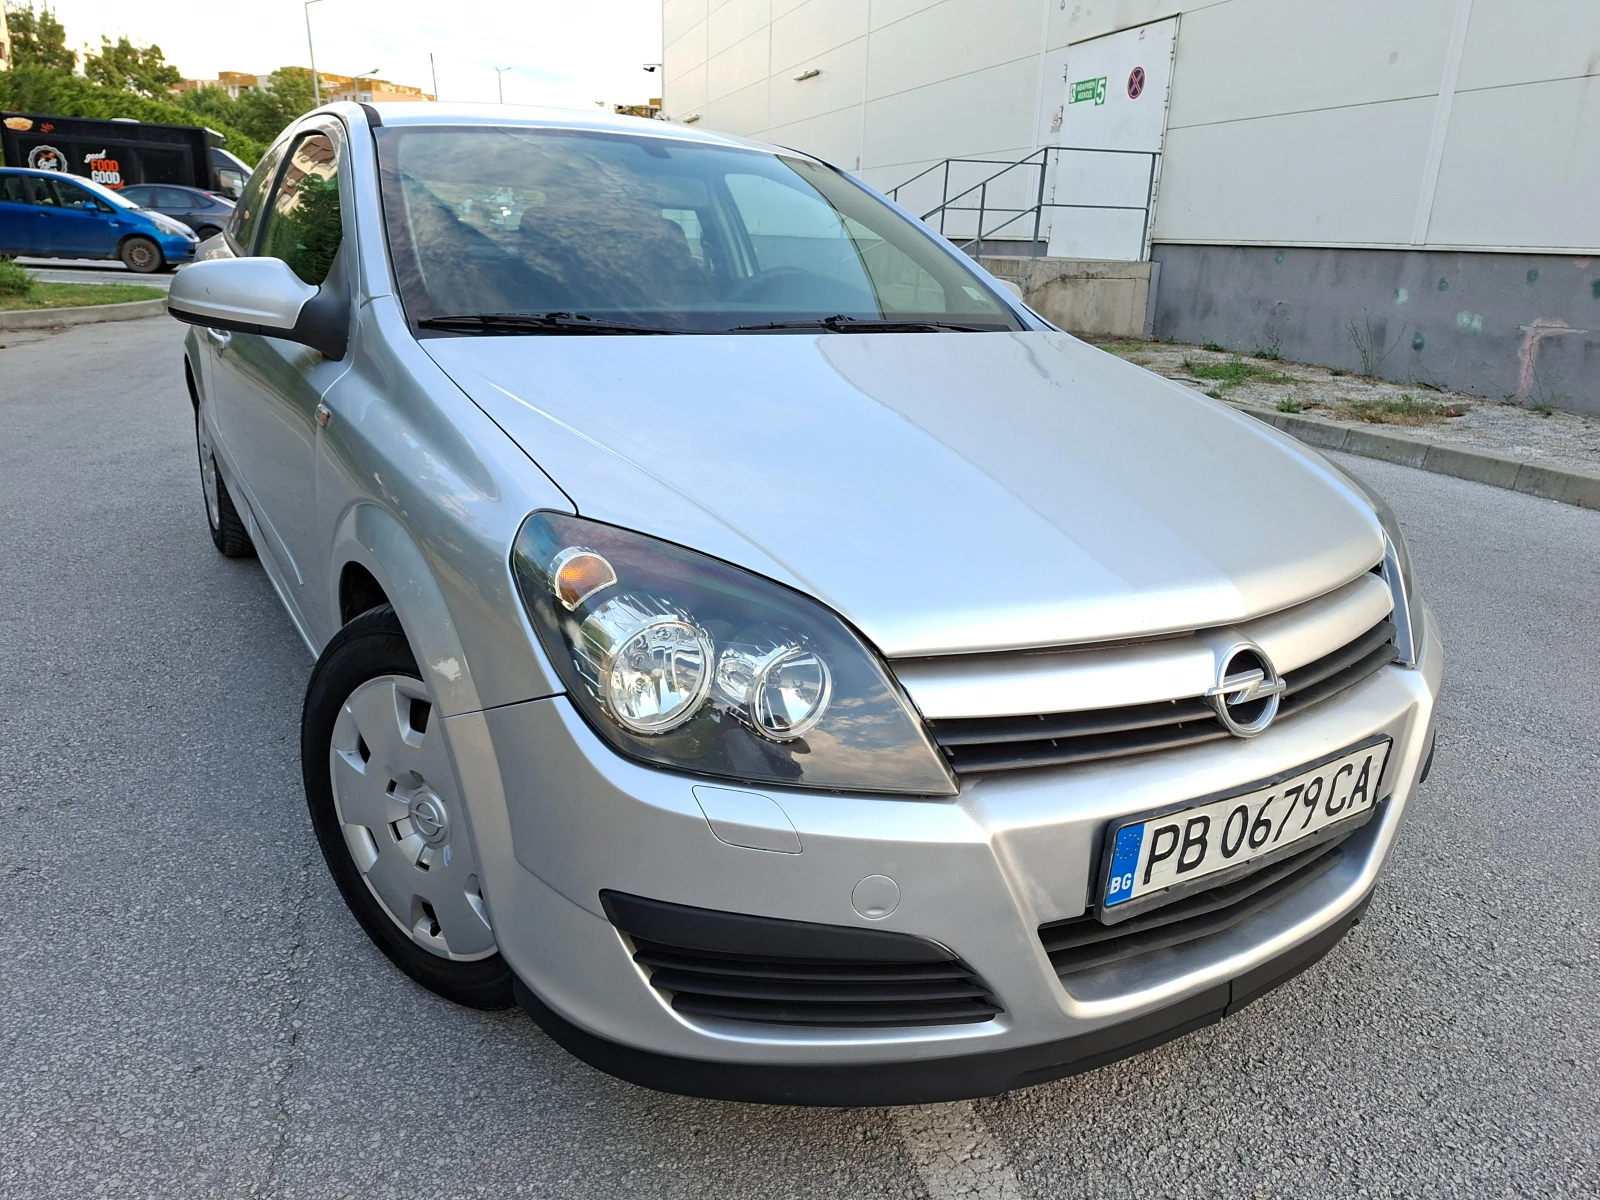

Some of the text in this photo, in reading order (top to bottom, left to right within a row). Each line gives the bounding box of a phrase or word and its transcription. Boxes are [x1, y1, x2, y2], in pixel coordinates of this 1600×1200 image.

[1095, 78, 1106, 104] 5
[90, 159, 119, 172] FOOD
[91, 170, 121, 184] GOOD
[1142, 815, 1211, 886] PB
[1109, 872, 1132, 895] BG
